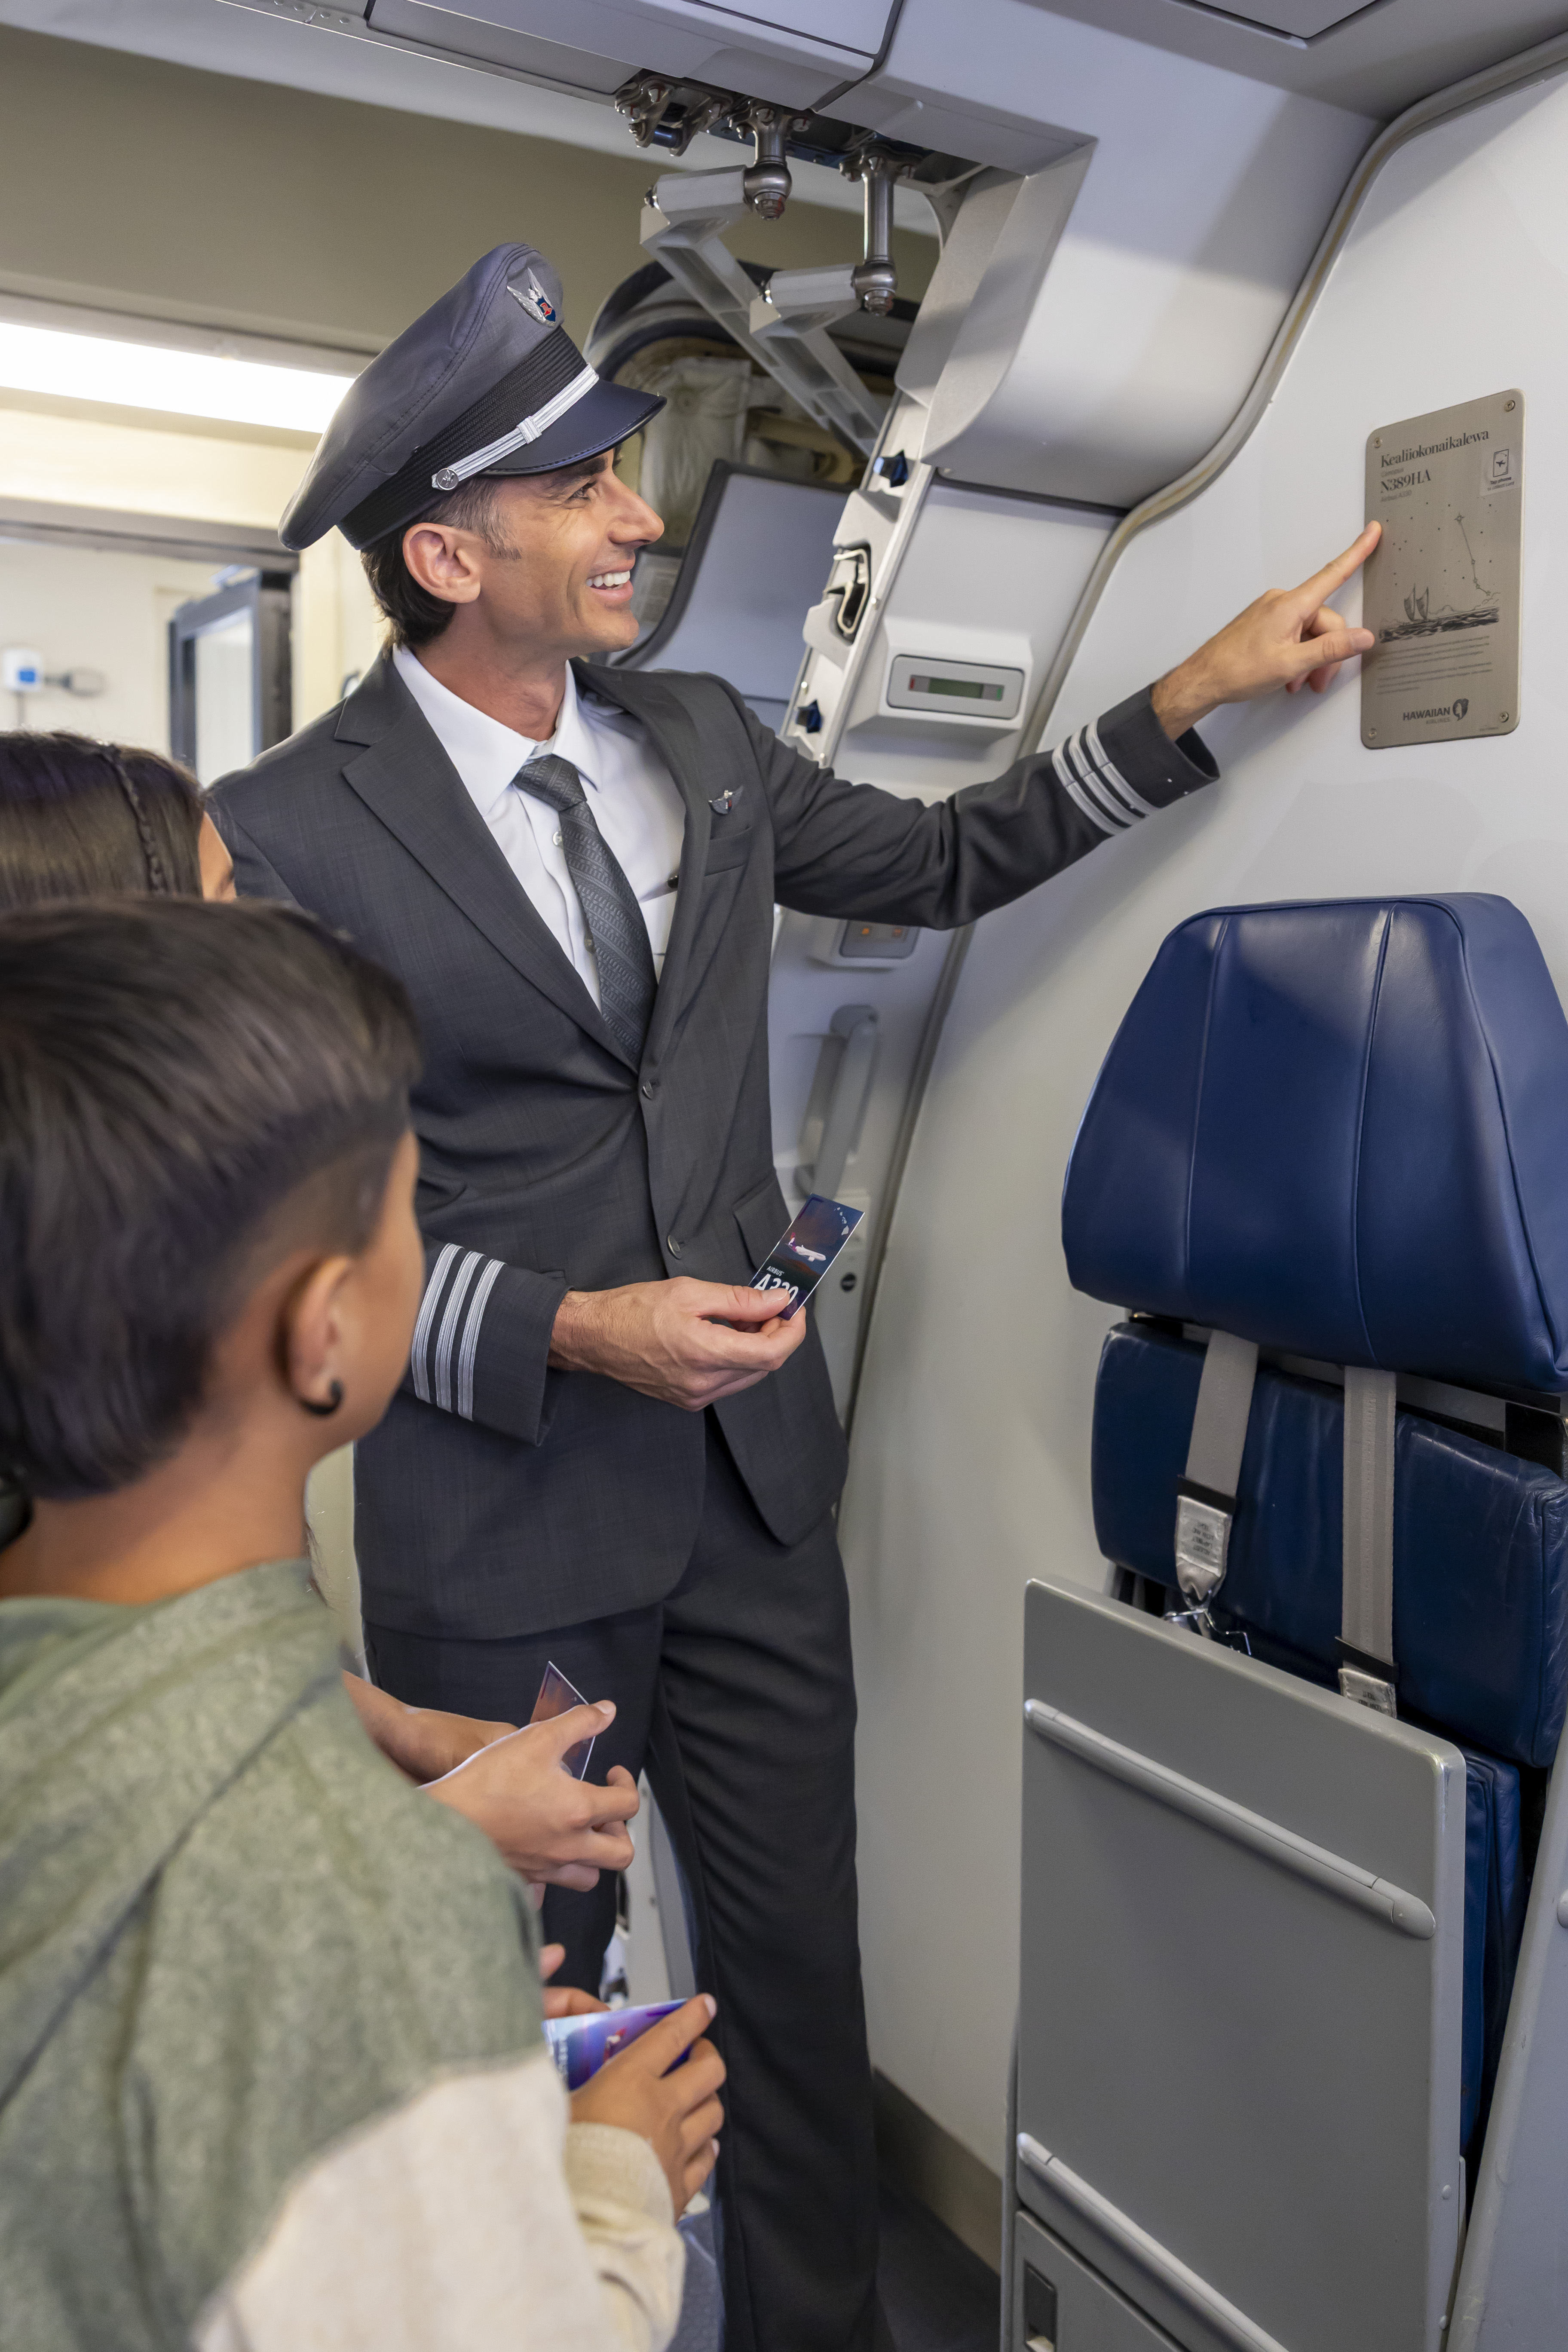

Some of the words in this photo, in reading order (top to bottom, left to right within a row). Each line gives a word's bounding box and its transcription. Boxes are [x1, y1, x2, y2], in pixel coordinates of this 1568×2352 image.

[1381, 430, 1489, 468] Kealiiokonaikalewa
[1381, 469, 1431, 493] N389HA
[1403, 707, 1451, 721] HAWAIIAN
[766, 1266, 783, 1277] AIRBUS
